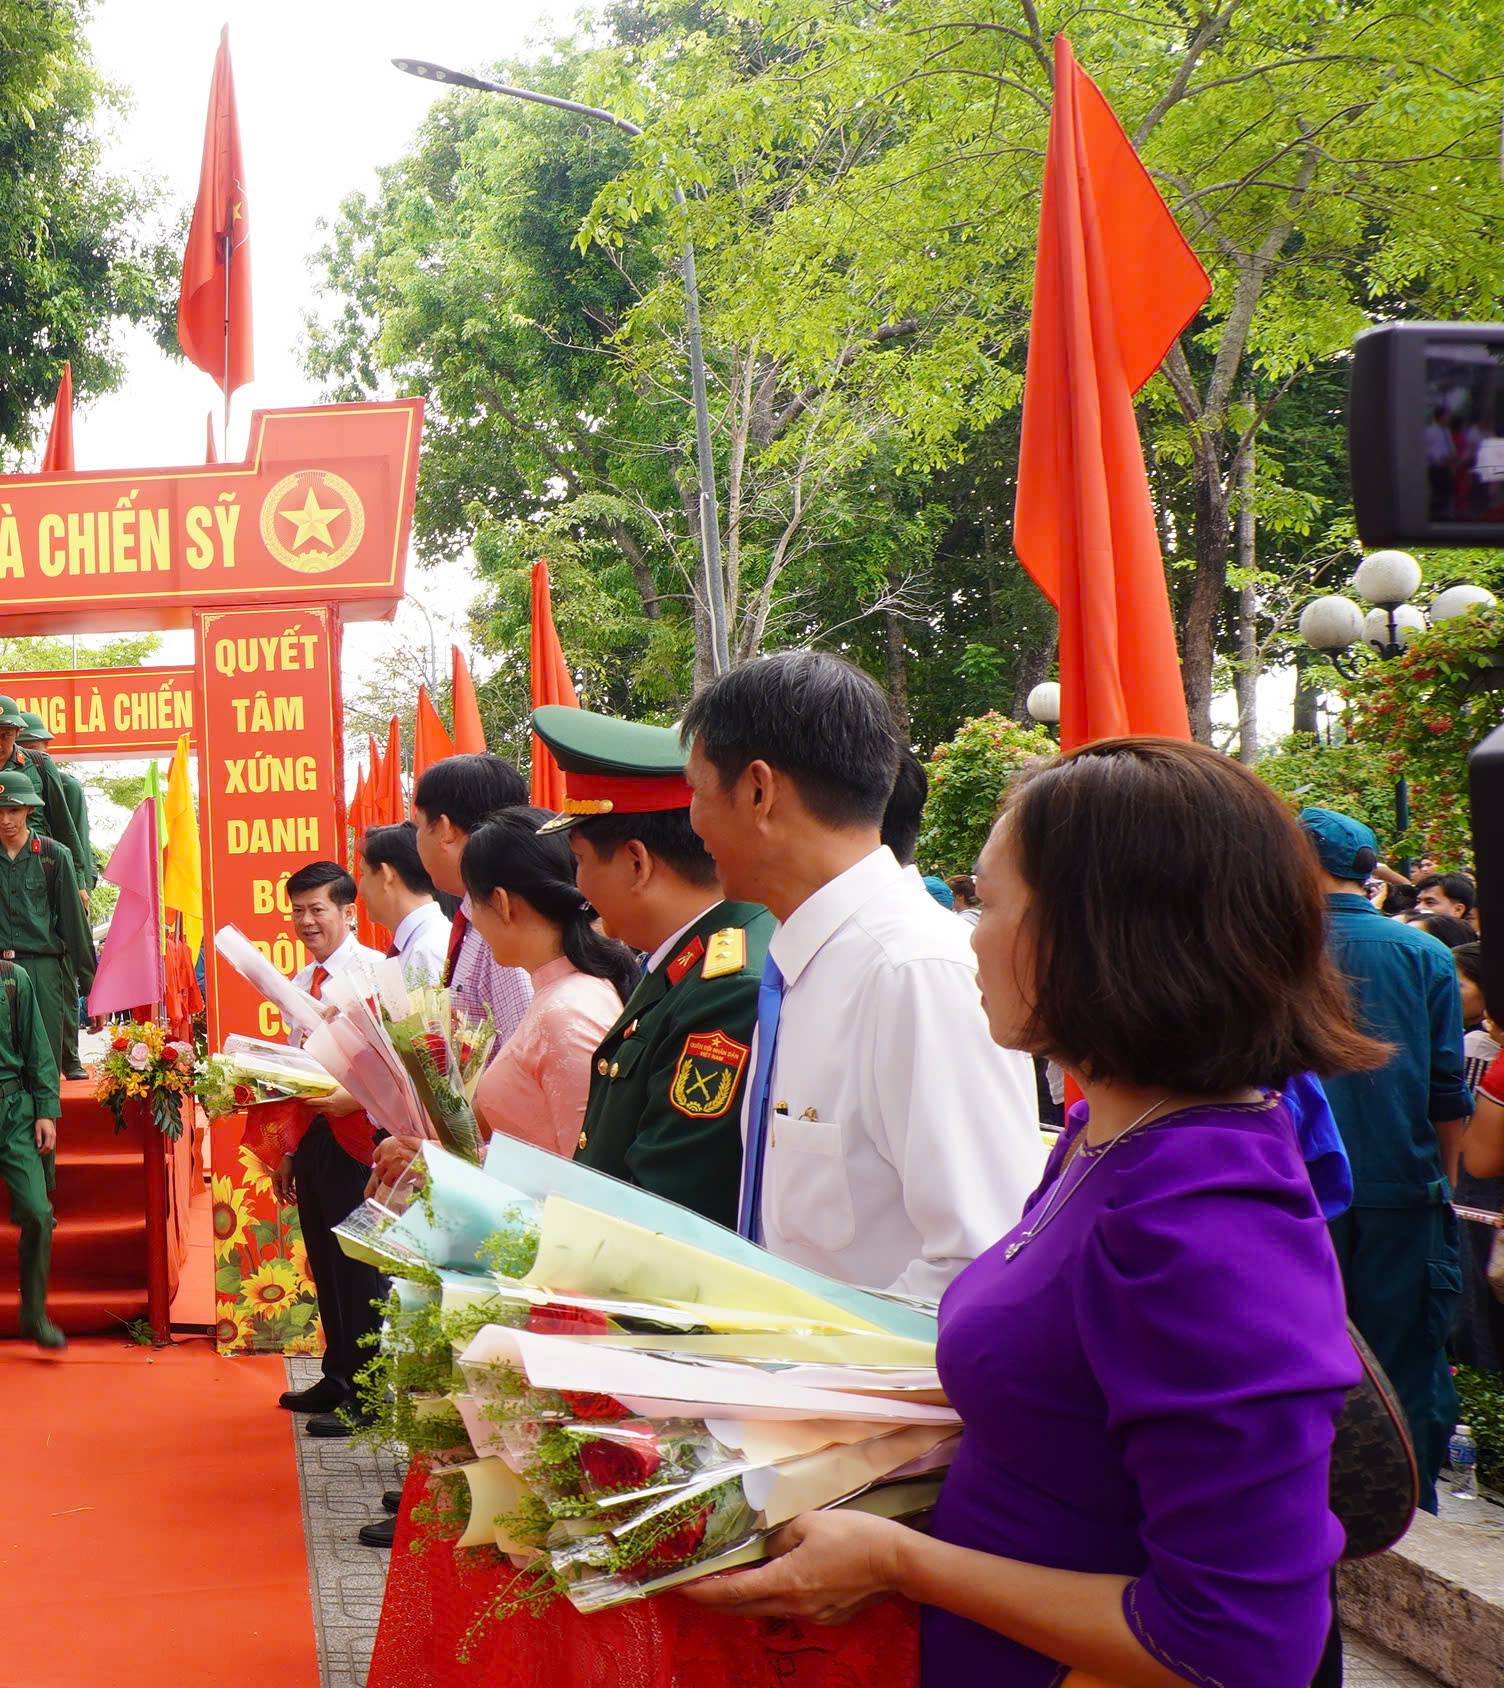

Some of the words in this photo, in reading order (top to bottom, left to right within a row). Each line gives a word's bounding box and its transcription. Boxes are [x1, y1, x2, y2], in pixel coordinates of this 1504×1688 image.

[38, 488, 171, 578] CHIẾN
[185, 492, 241, 571] SỸ
[214, 624, 319, 678] QUYẾT
[74, 686, 107, 733] LÀ
[113, 678, 193, 732] CHIẾN
[231, 690, 305, 733] TÂM
[224, 751, 317, 794] XỨNG
[227, 816, 320, 855] DANH
